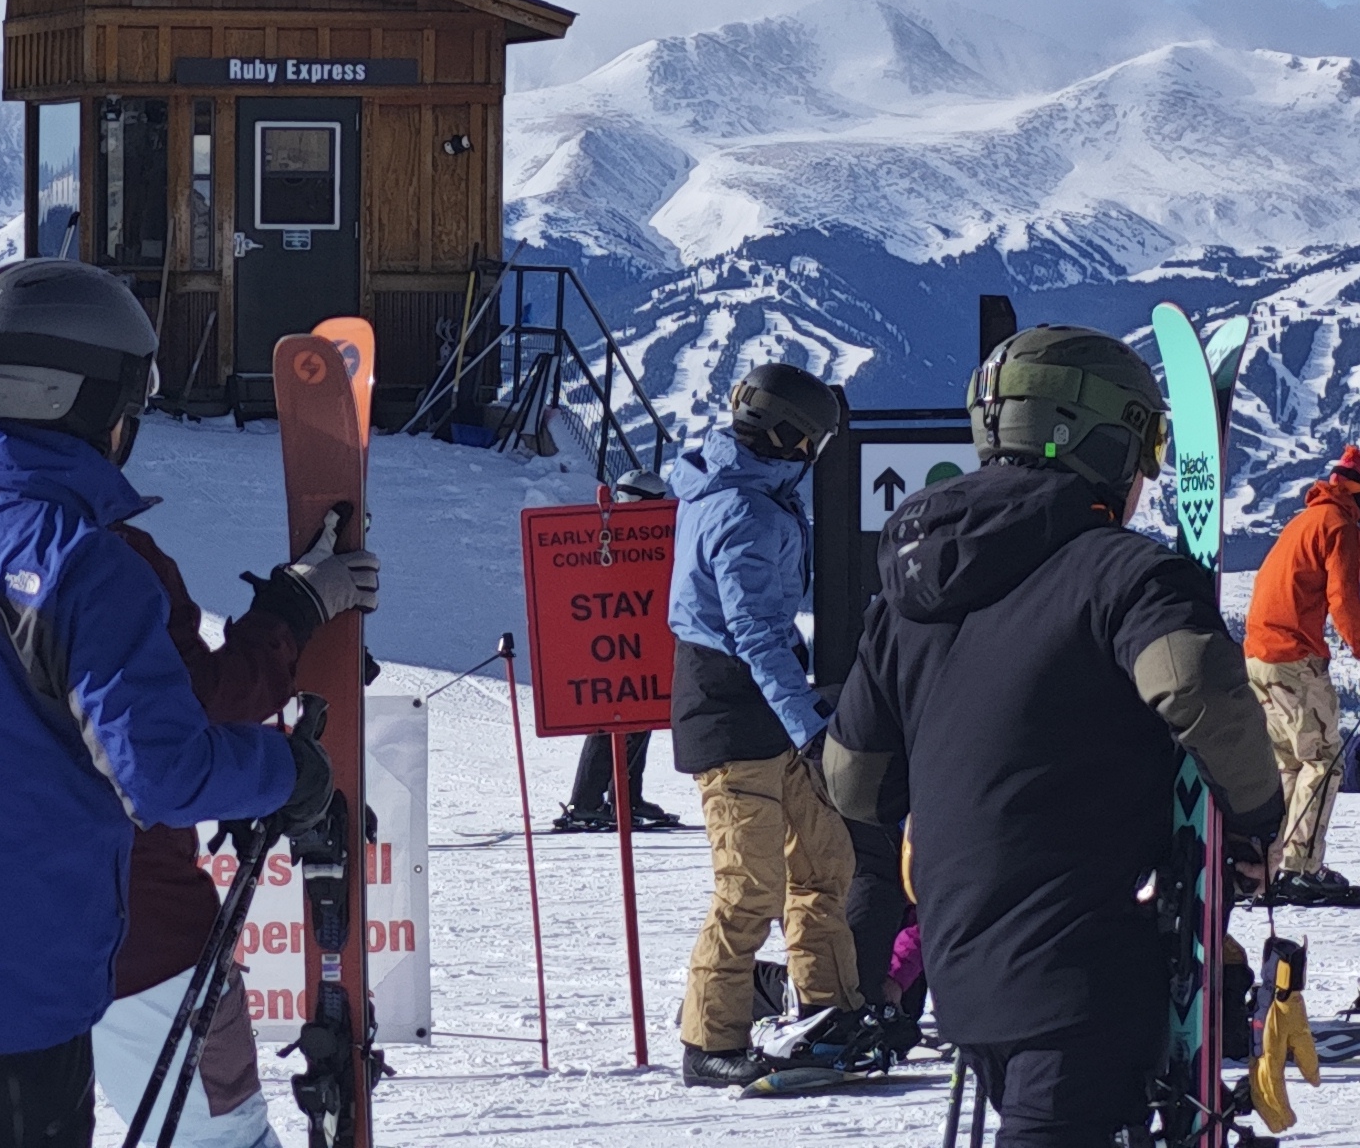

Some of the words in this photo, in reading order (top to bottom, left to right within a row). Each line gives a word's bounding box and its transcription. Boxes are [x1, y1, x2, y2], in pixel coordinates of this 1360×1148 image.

[229, 59, 277, 83] Ruby
[286, 59, 366, 83] Express
[1180, 451, 1209, 475] black
[1180, 473, 1215, 492] crows
[538, 529, 596, 547] EARLY
[606, 524, 675, 542] EASON
[553, 547, 666, 568] CONDTIONS
[571, 590, 654, 621] STAY
[592, 633, 642, 662] ON
[567, 674, 671, 705] TRAIL
